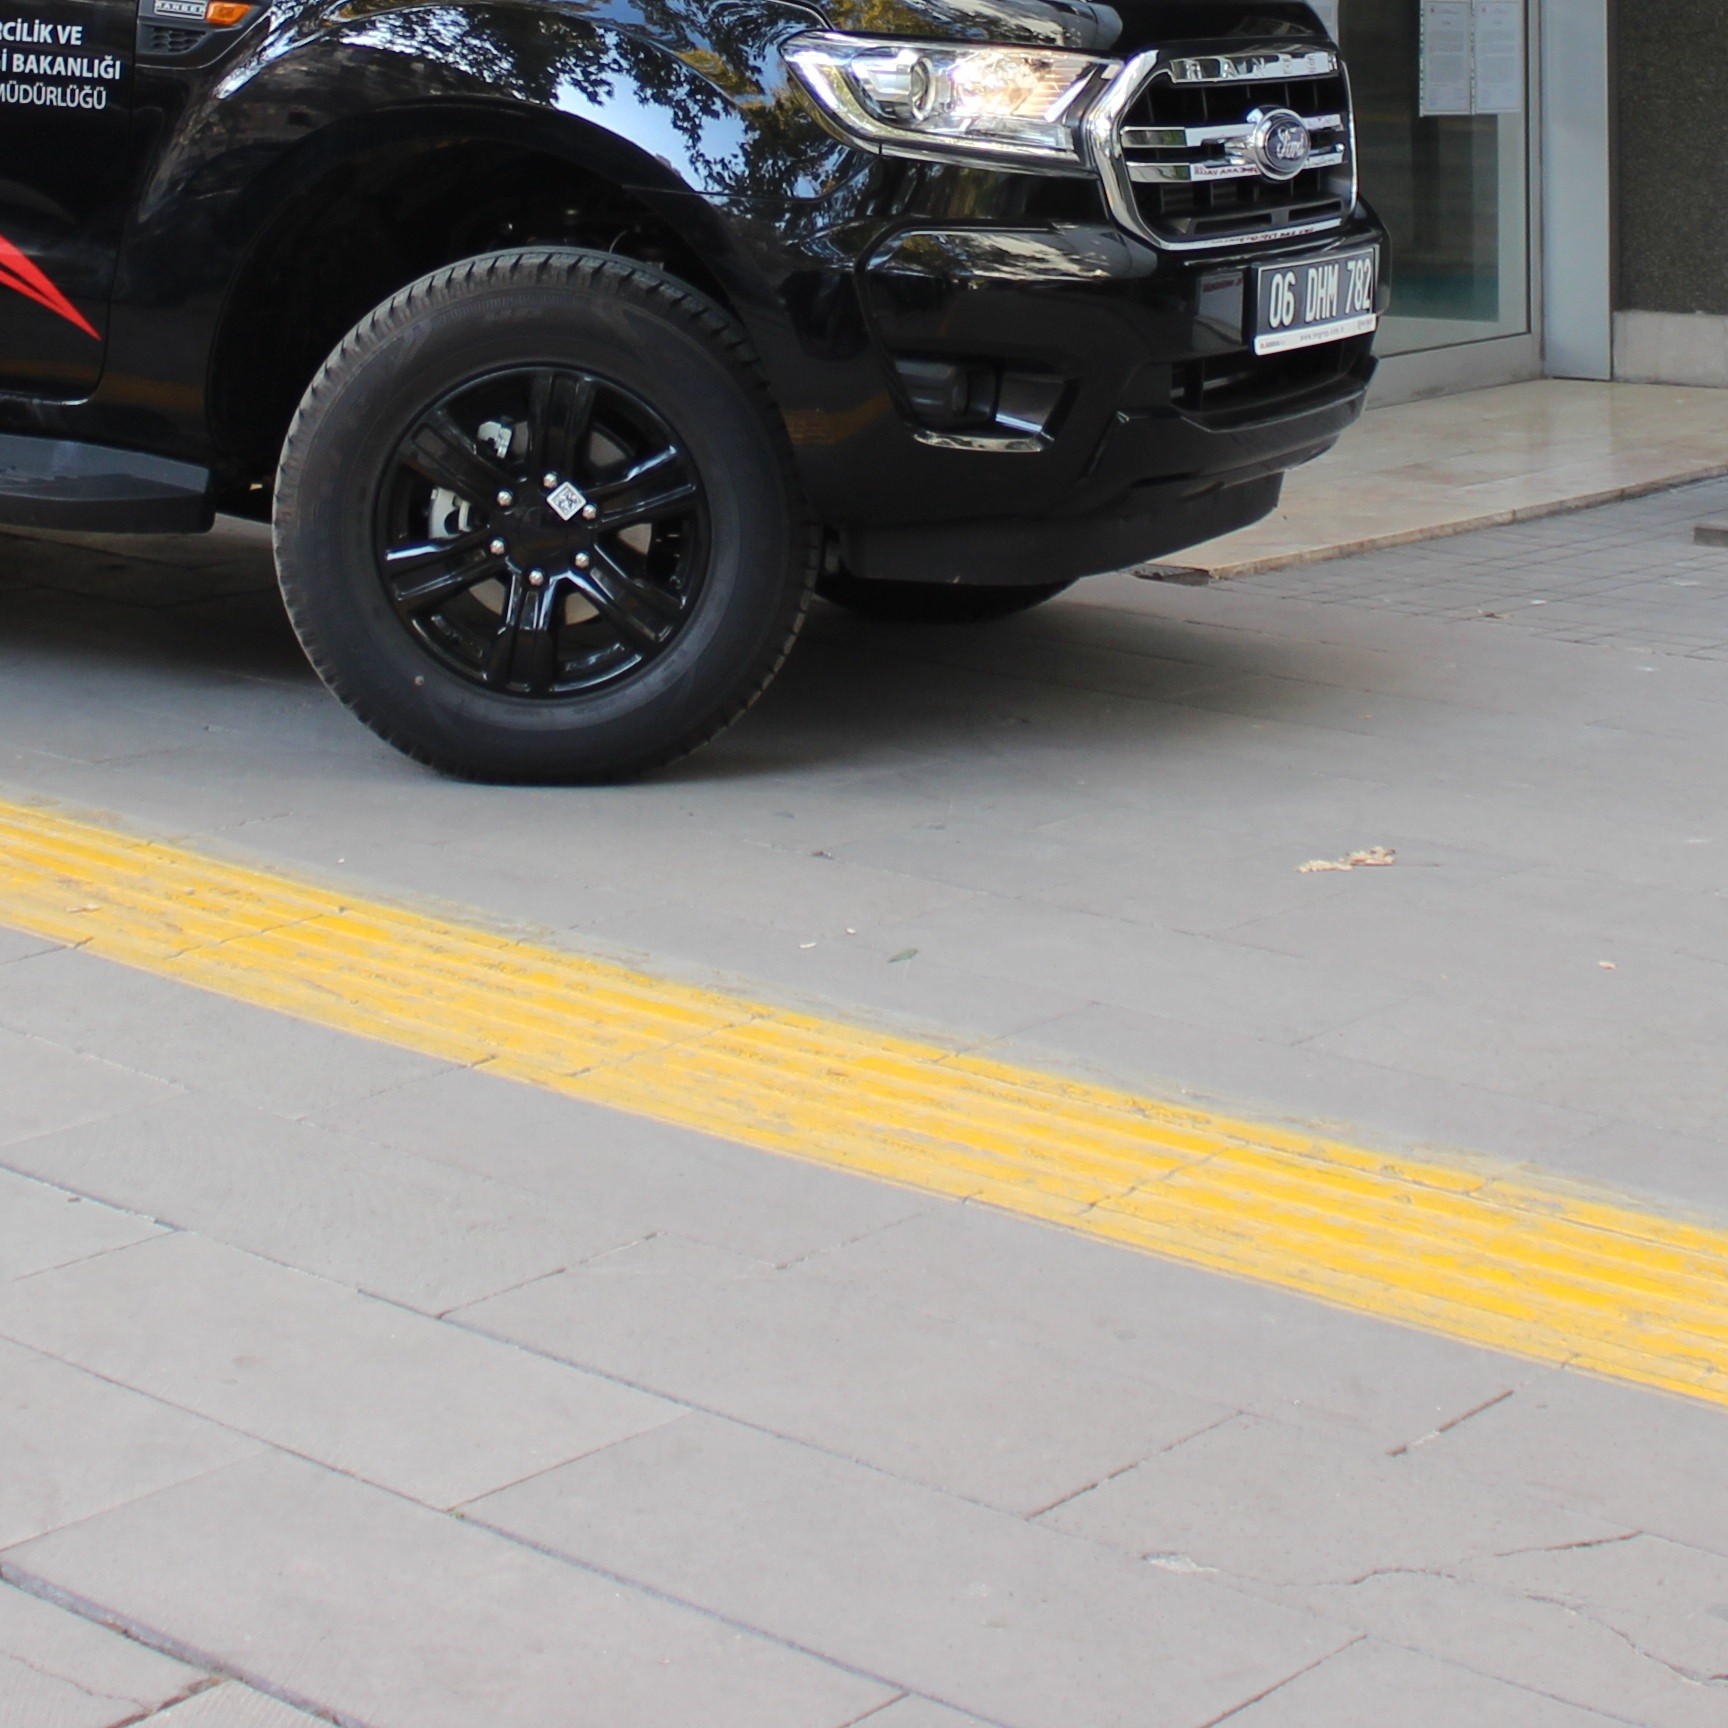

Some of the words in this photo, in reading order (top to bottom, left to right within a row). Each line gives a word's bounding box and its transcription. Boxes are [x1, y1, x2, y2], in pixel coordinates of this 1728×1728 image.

[56, 24, 83, 47] VE
[12, 52, 122, 81] BAKANLIĞI
[1276, 127, 1306, 160] Ford
[1269, 271, 1296, 329] 06
[1305, 263, 1339, 323] DHM
[1345, 258, 1372, 314] 782
